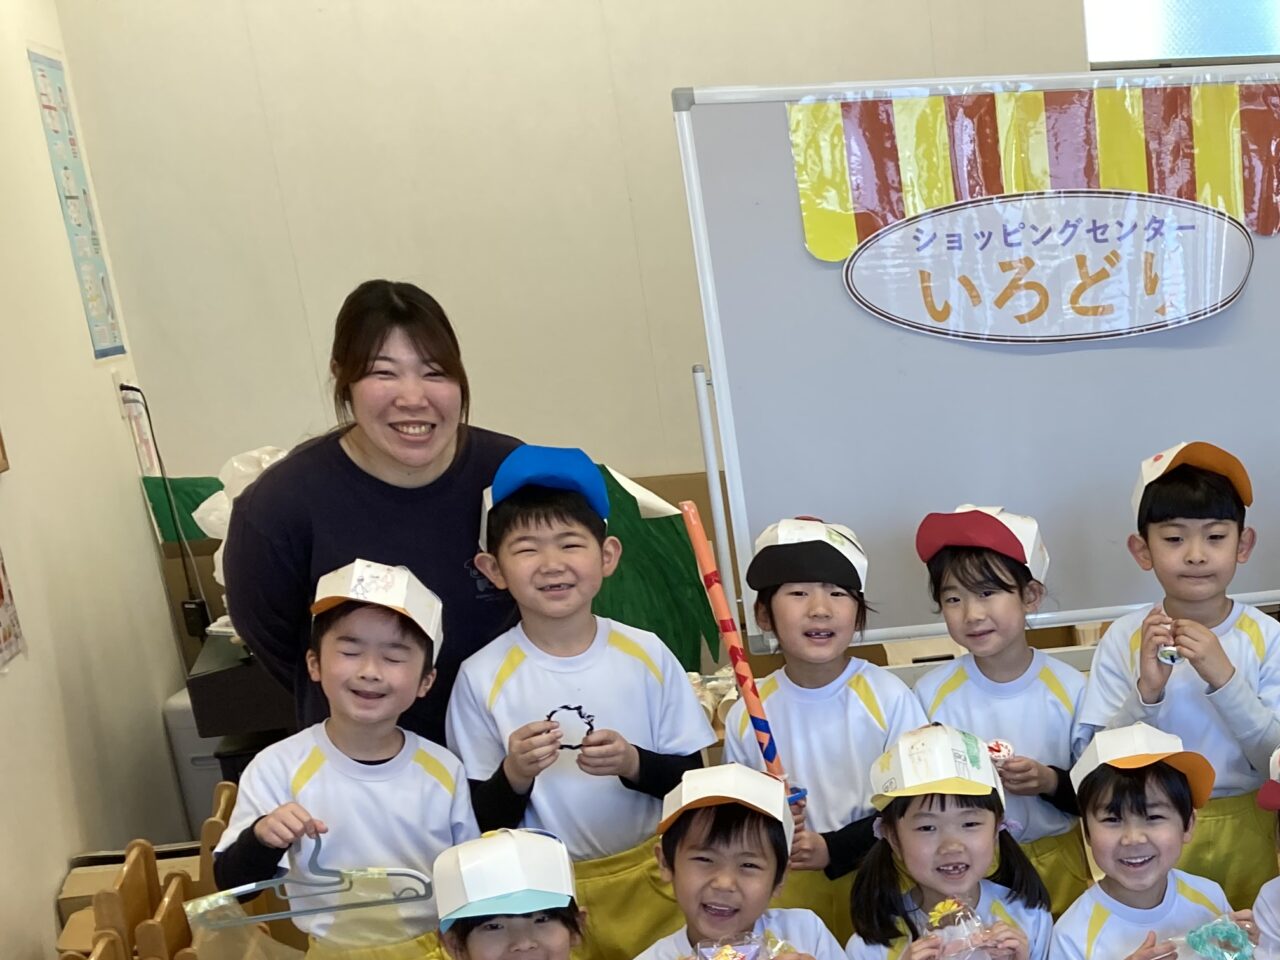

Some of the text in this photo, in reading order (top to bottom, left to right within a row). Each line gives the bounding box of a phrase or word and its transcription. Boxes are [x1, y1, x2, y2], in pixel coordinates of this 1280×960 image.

[912, 215, 1196, 252] ショッピングセンター
